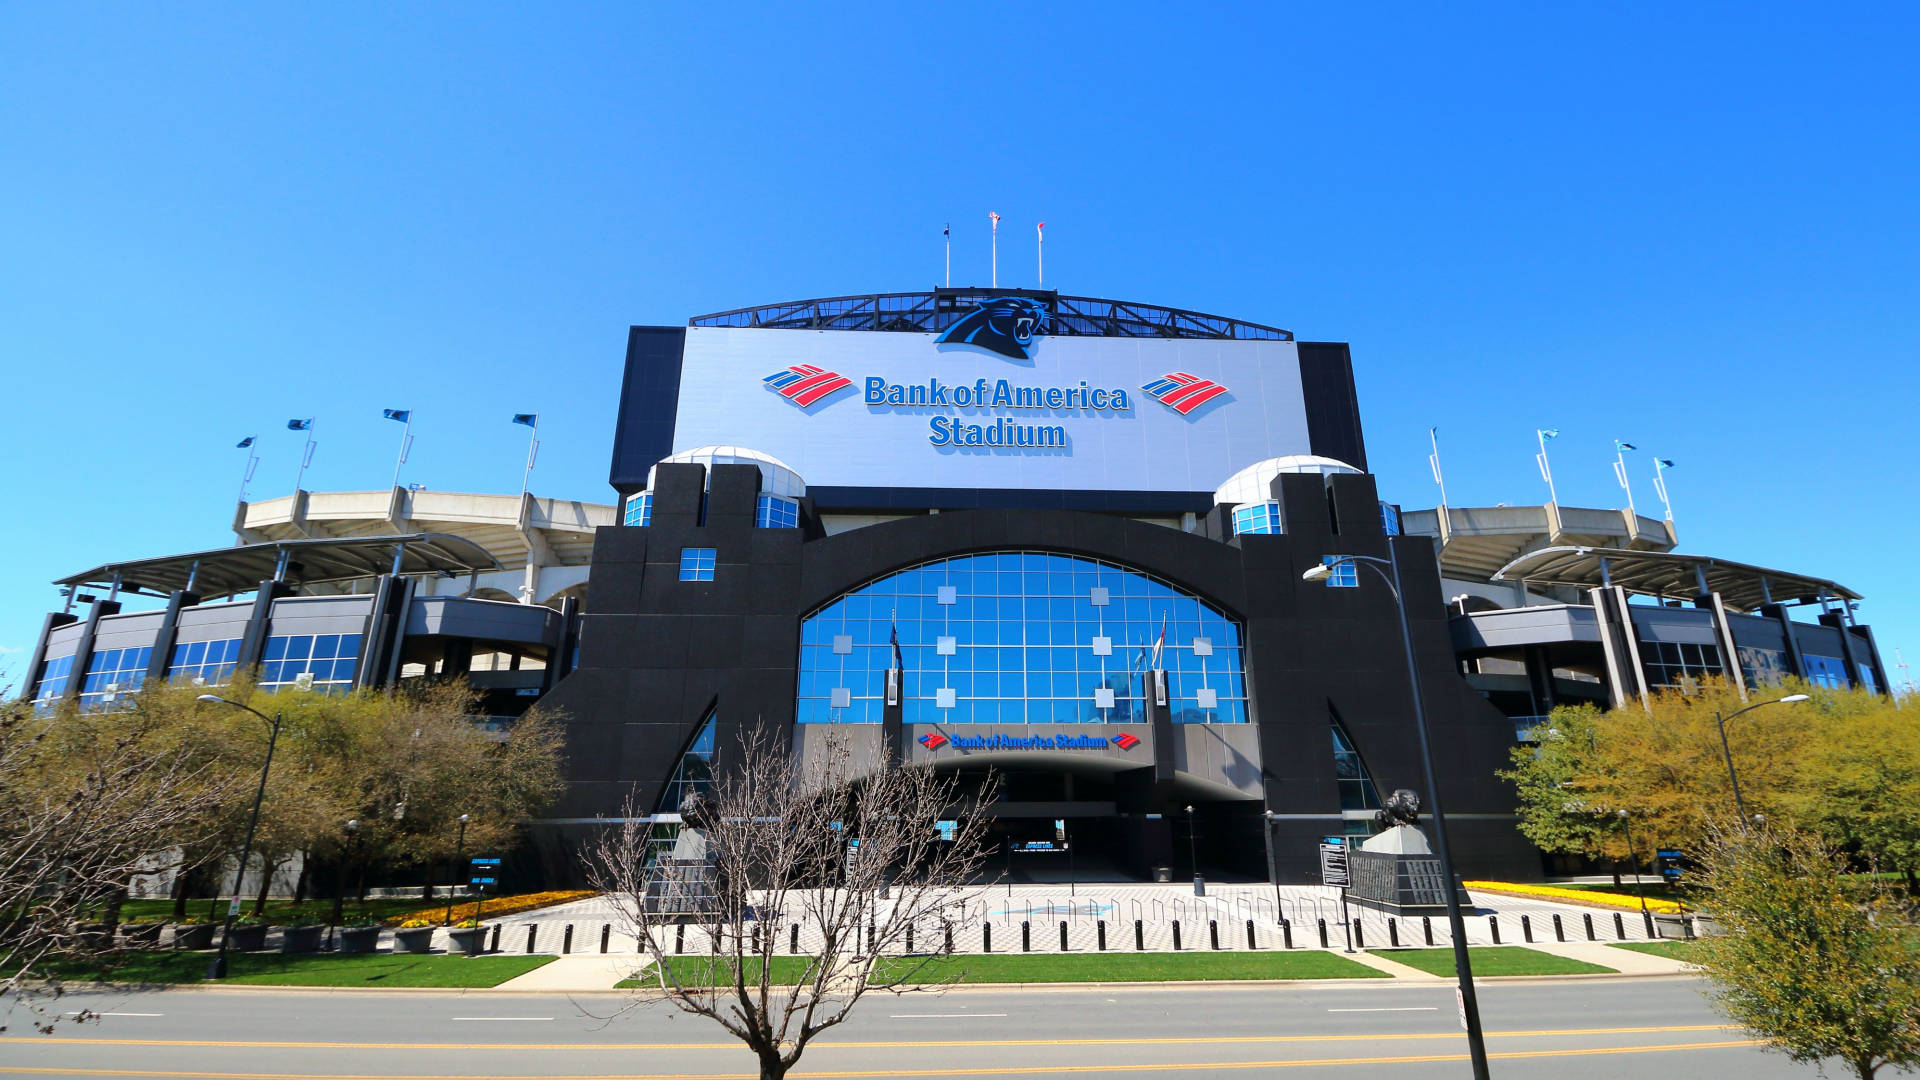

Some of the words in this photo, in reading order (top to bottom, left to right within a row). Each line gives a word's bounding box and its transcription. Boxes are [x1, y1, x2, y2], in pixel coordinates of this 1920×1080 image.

[864, 376, 948, 405] Bank
[952, 378, 987, 406] of
[990, 378, 1129, 409] America
[928, 415, 1066, 447] Stadium
[951, 734, 983, 747] Bank
[985, 734, 1000, 747] of
[1000, 734, 1054, 747] America
[1055, 734, 1108, 747] Stadium
